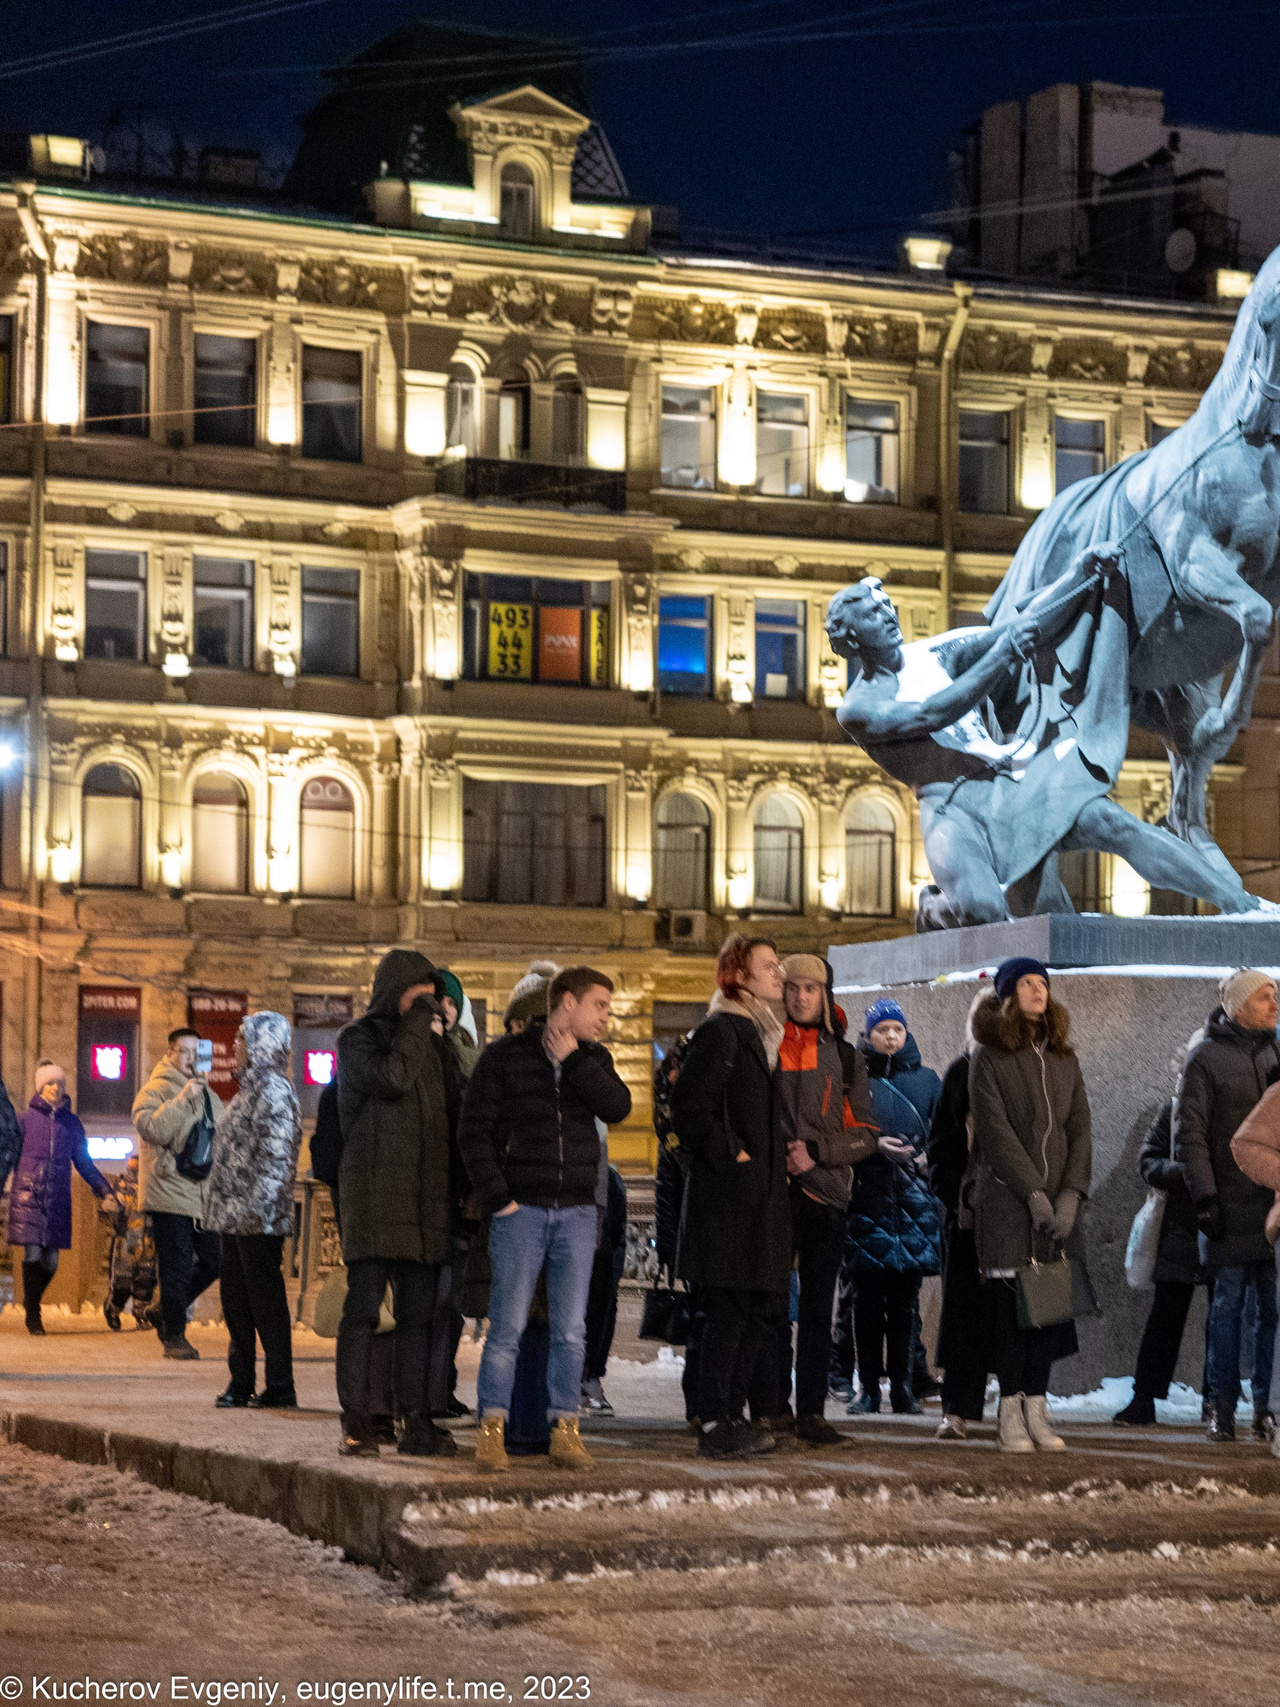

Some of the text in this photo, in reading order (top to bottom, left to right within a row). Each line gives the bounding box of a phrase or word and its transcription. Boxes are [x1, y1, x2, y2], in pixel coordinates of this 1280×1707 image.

[491, 606, 530, 630] 493
[497, 630, 523, 651] 44
[497, 652, 521, 674] 33
